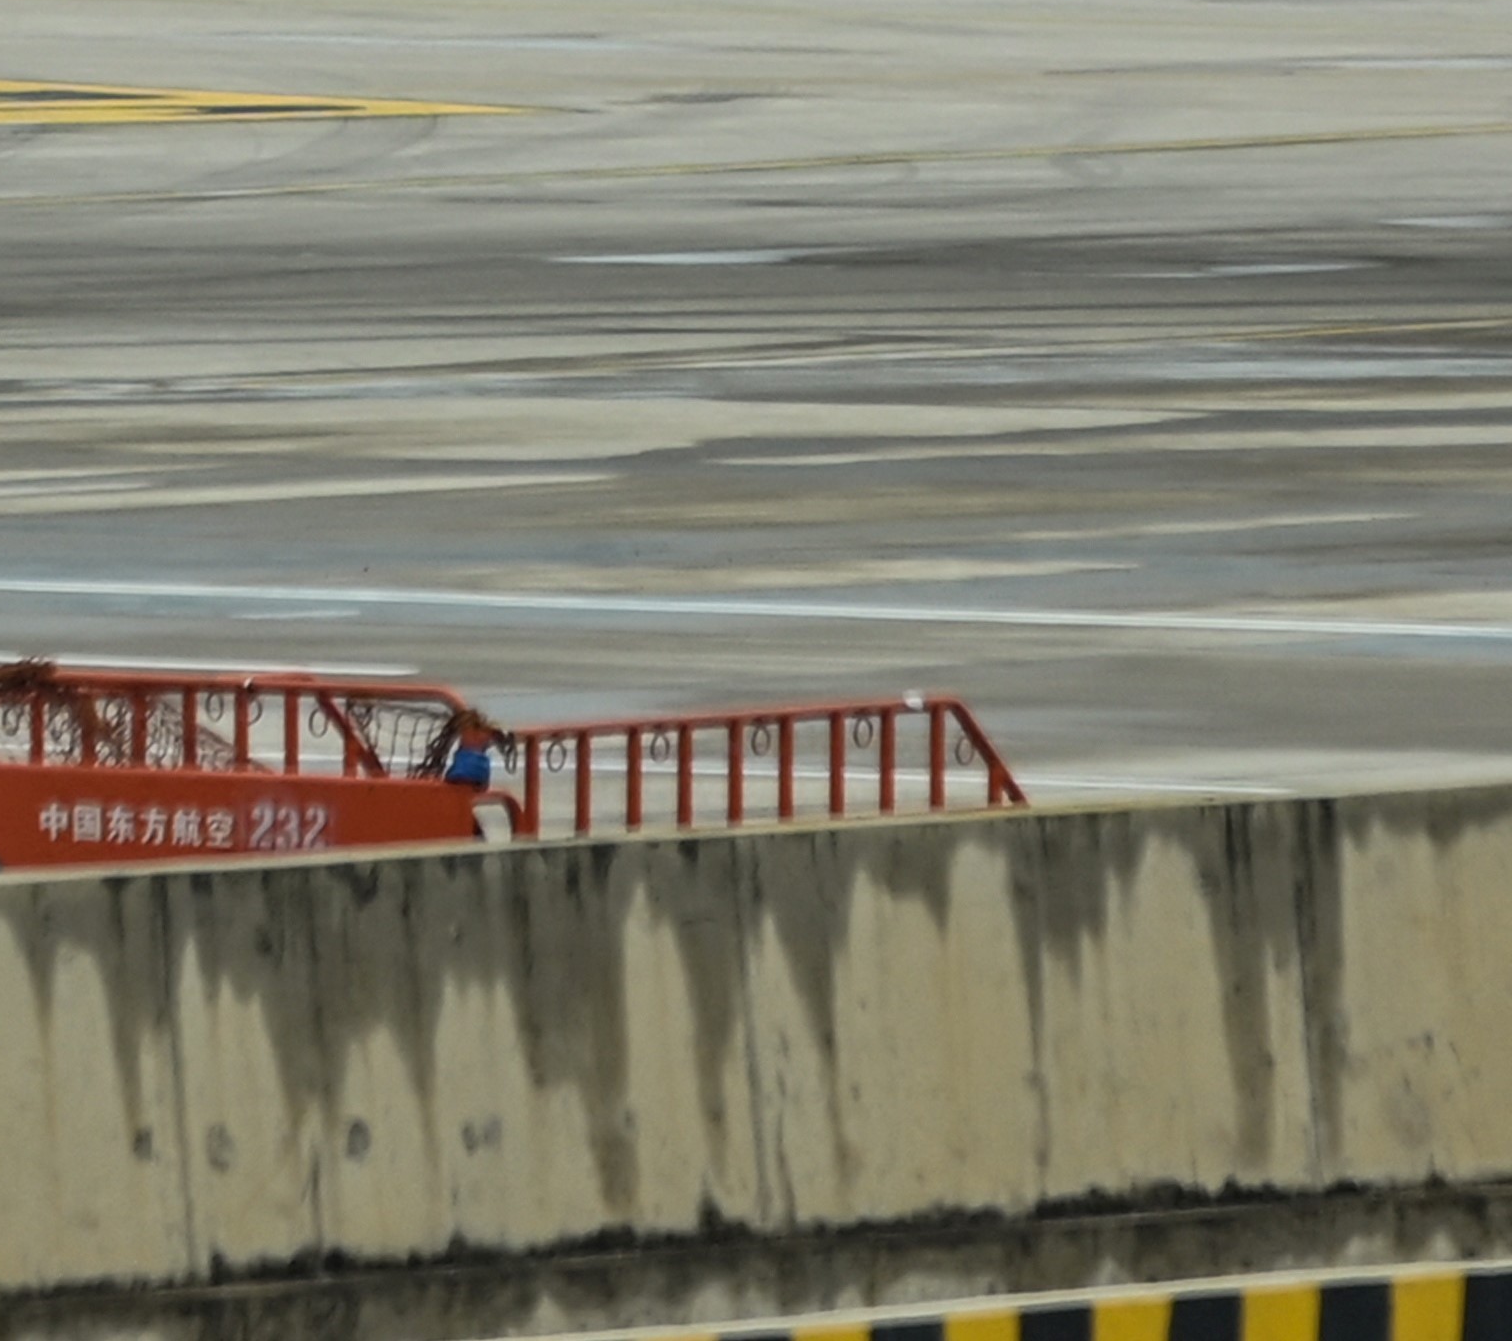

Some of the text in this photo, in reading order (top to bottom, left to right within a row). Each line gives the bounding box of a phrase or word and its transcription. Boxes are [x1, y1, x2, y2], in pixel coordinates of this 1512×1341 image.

[39, 801, 330, 850] 中国东方航空 232
